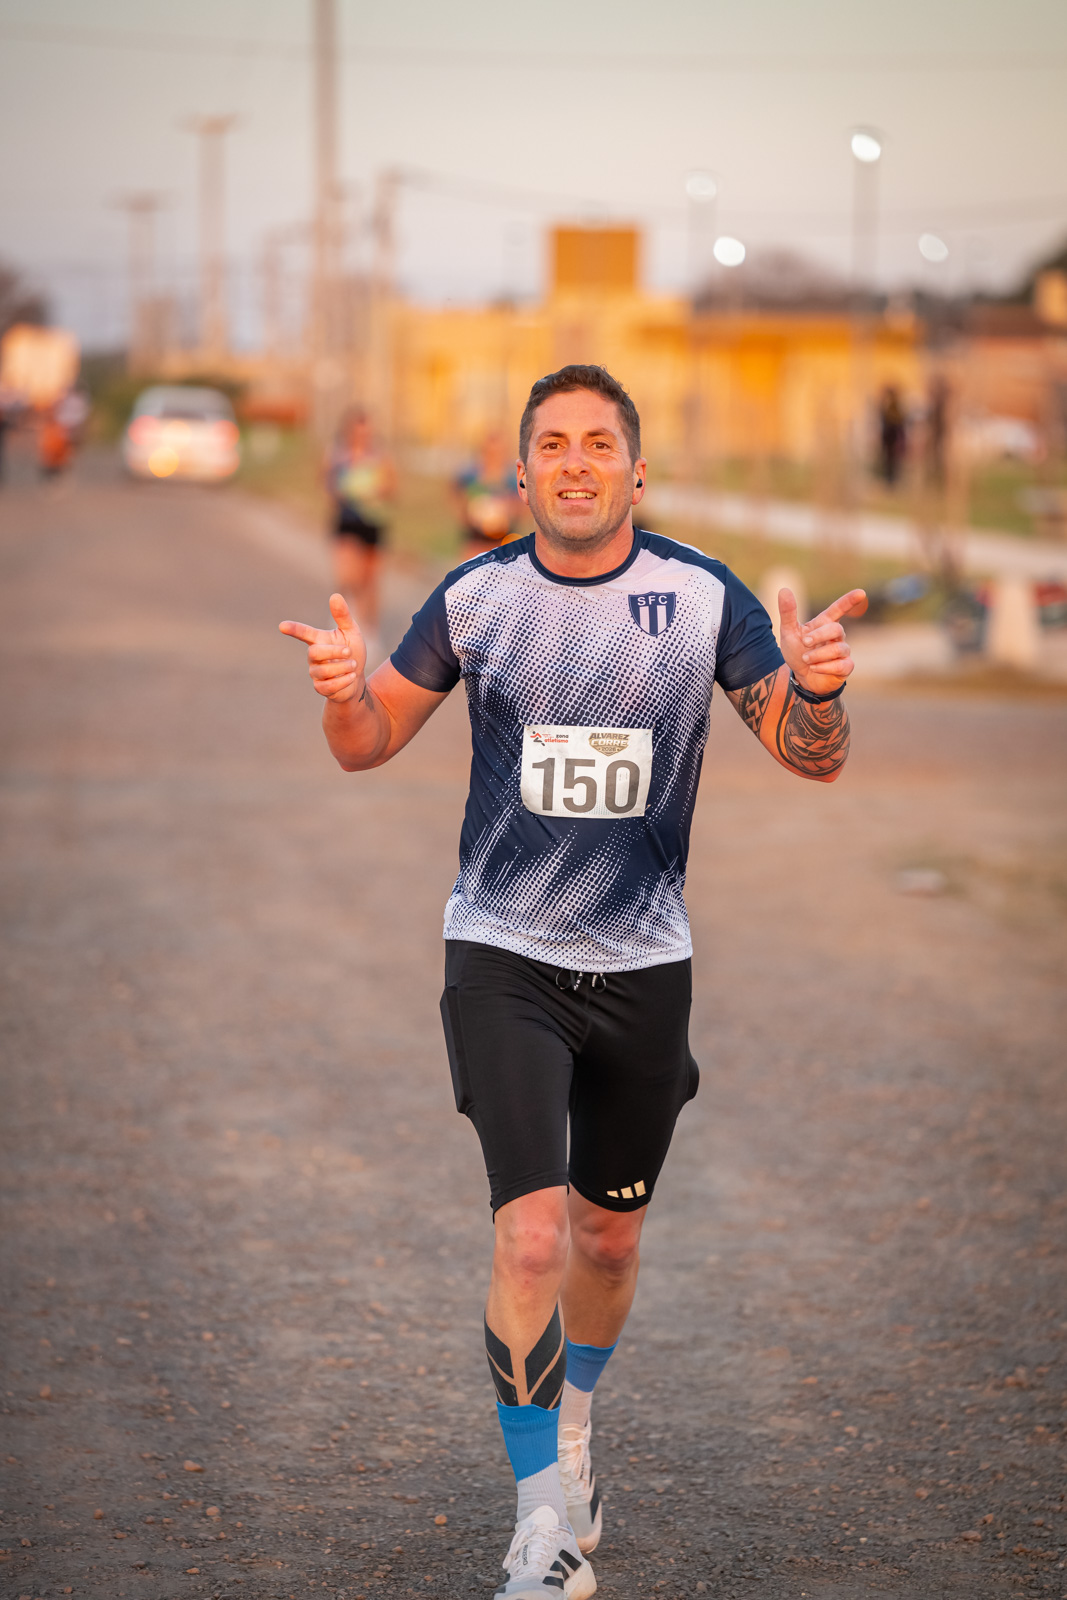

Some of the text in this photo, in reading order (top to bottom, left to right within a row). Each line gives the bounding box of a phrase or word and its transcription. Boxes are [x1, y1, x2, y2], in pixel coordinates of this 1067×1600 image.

[637, 595, 668, 606] SFC
[591, 739, 628, 748] CORRE
[532, 757, 640, 814] 150
